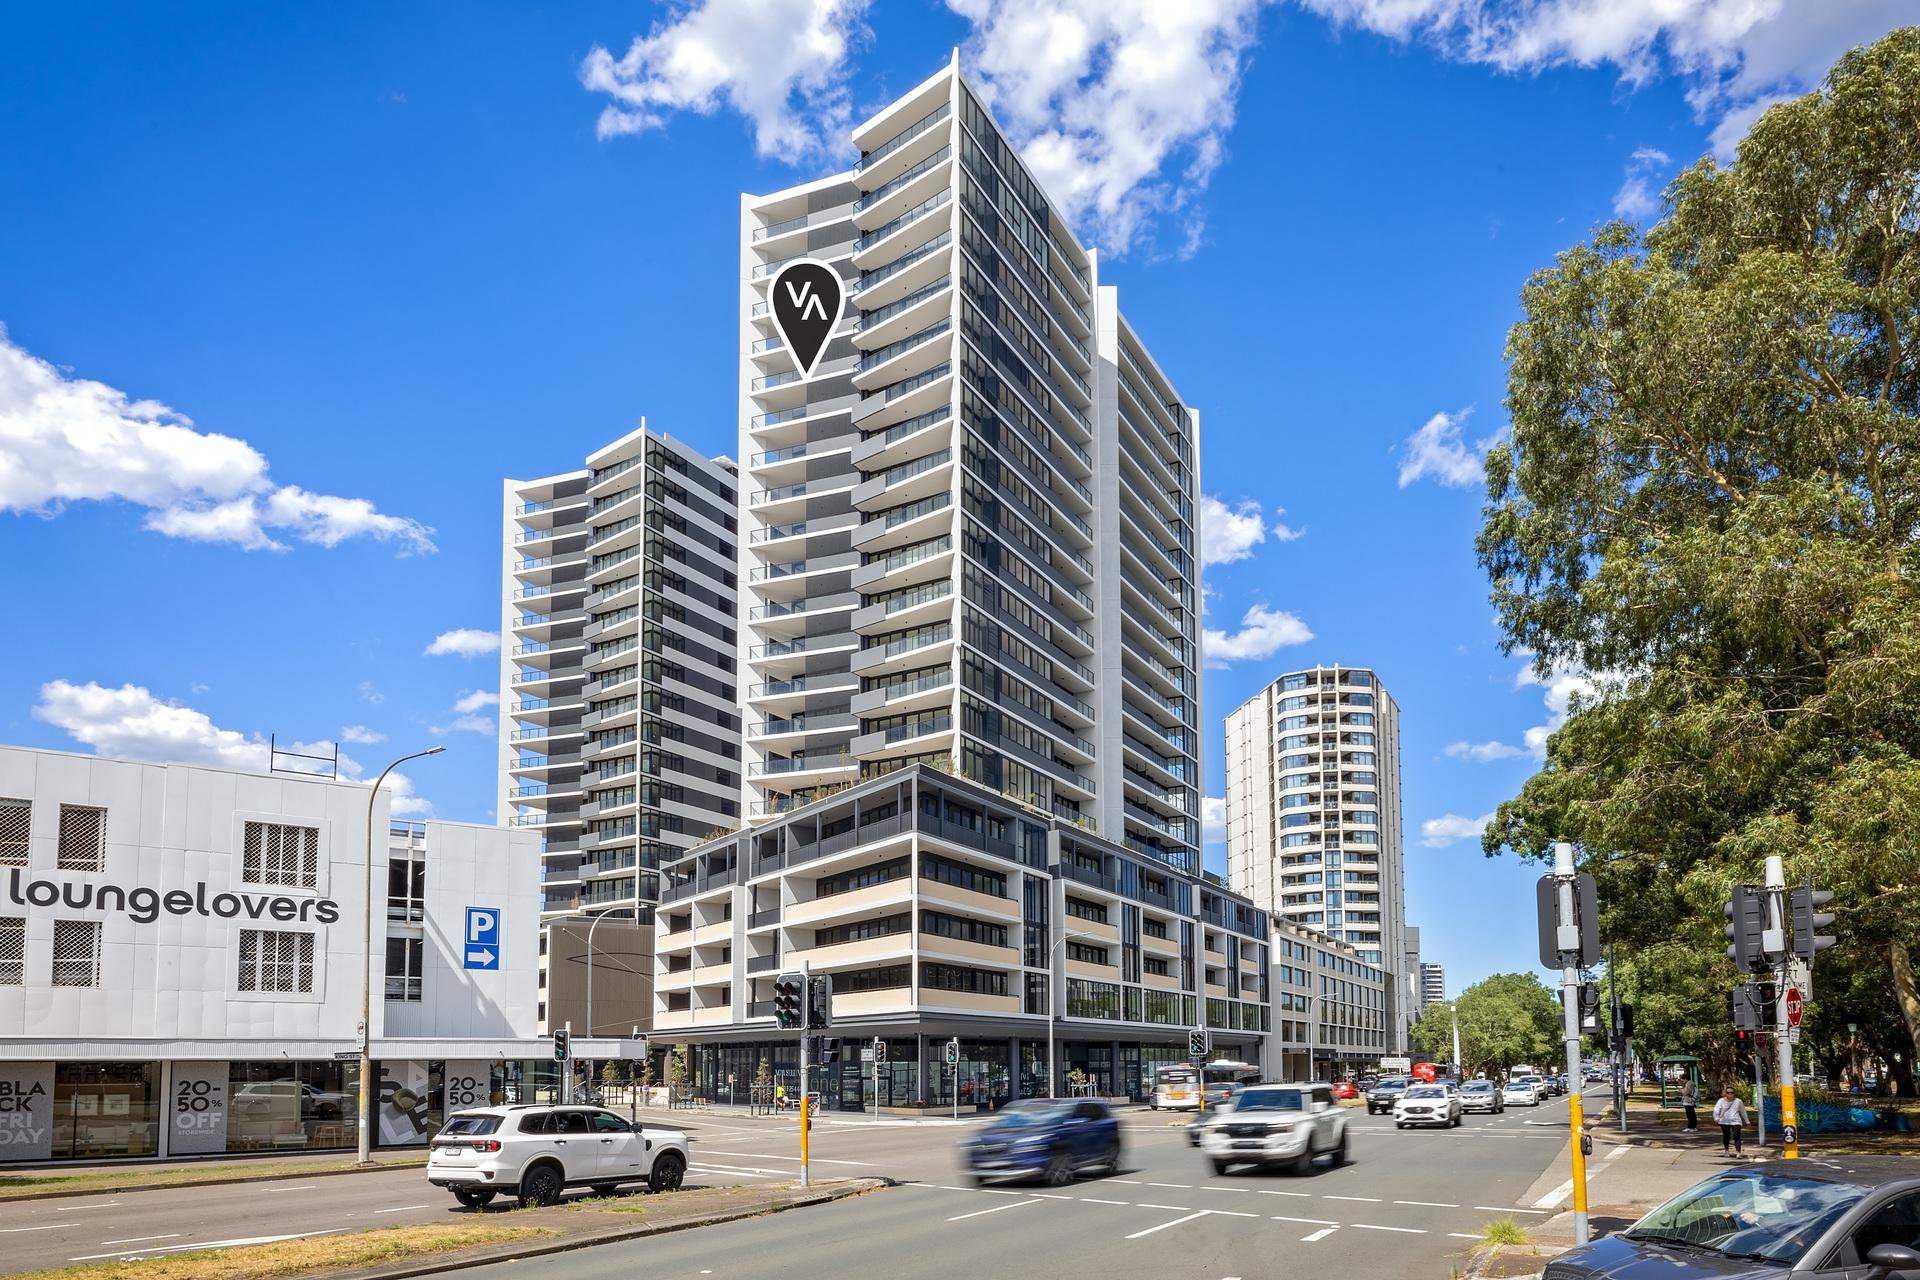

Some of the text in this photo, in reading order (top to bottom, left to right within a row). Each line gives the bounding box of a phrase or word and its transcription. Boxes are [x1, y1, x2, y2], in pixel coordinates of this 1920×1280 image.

[10, 868, 340, 924] loungelovers
[470, 911, 495, 941] P
[1788, 1000, 1801, 1014] STOP
[0, 1080, 46, 1096] BLA
[177, 1080, 221, 1096] 20-
[449, 1076, 484, 1091] 20-
[0, 1096, 33, 1112] CK
[177, 1096, 223, 1112] 50%
[449, 1091, 486, 1106] 50%
[176, 1112, 222, 1129] OFF
